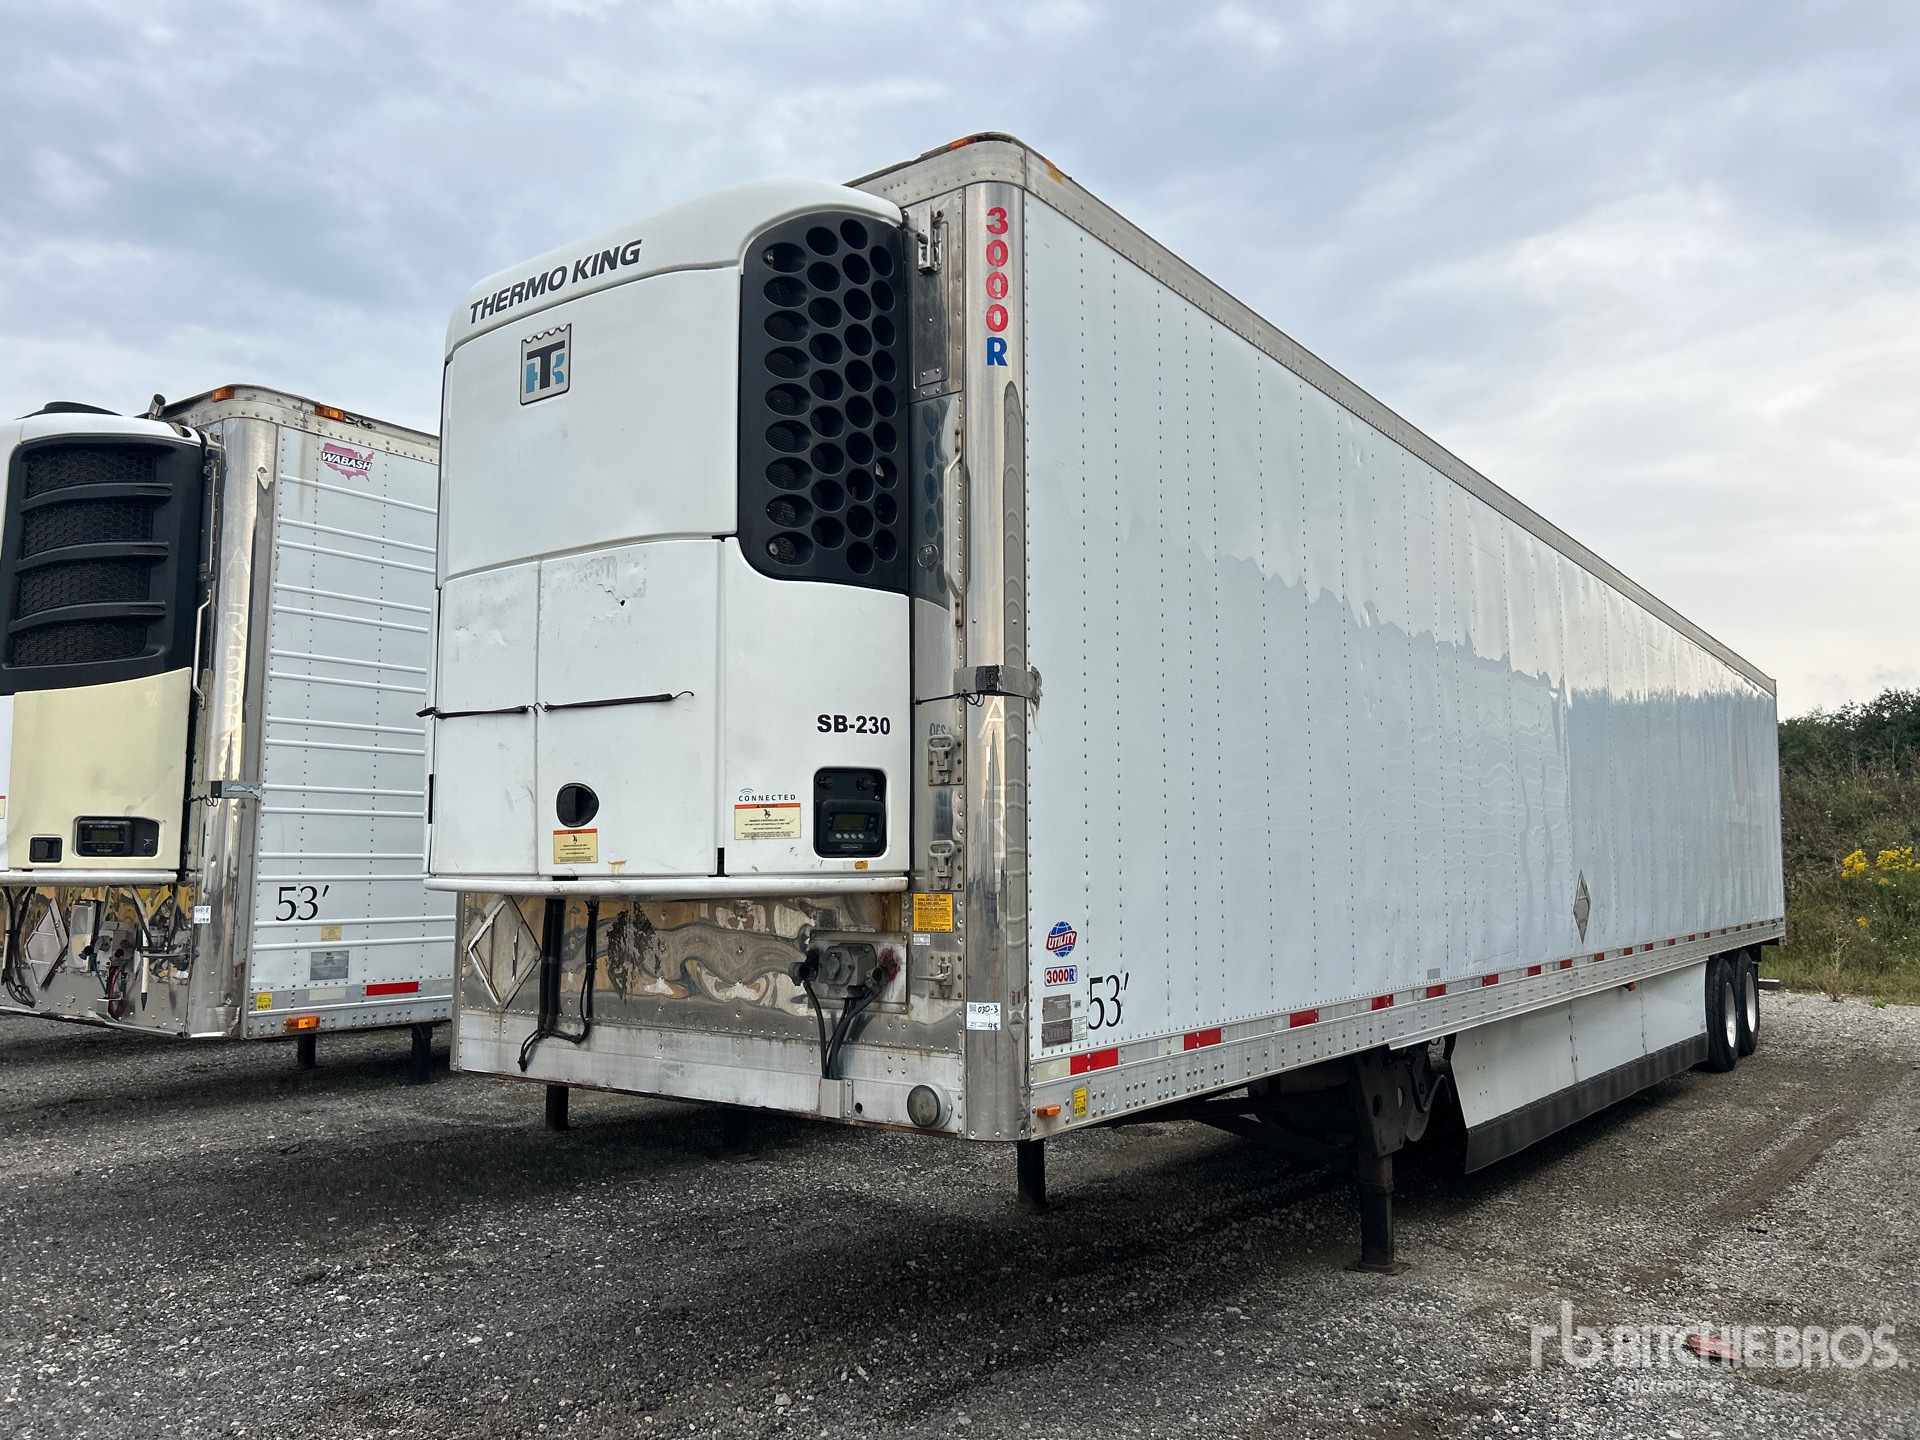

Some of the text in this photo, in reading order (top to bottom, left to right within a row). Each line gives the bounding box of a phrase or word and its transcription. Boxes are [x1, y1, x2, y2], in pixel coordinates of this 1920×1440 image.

[469, 239, 643, 325] THERMO KING
[985, 206, 1009, 367] 3000R
[322, 452, 371, 471] WABASH
[816, 714, 891, 736] SB-230
[738, 794, 796, 802] CONNECTED
[275, 884, 330, 922] 53'
[1047, 931, 1077, 949] UTILITY
[1046, 968, 1076, 984] 3000R
[1088, 972, 1130, 1031] 53'
